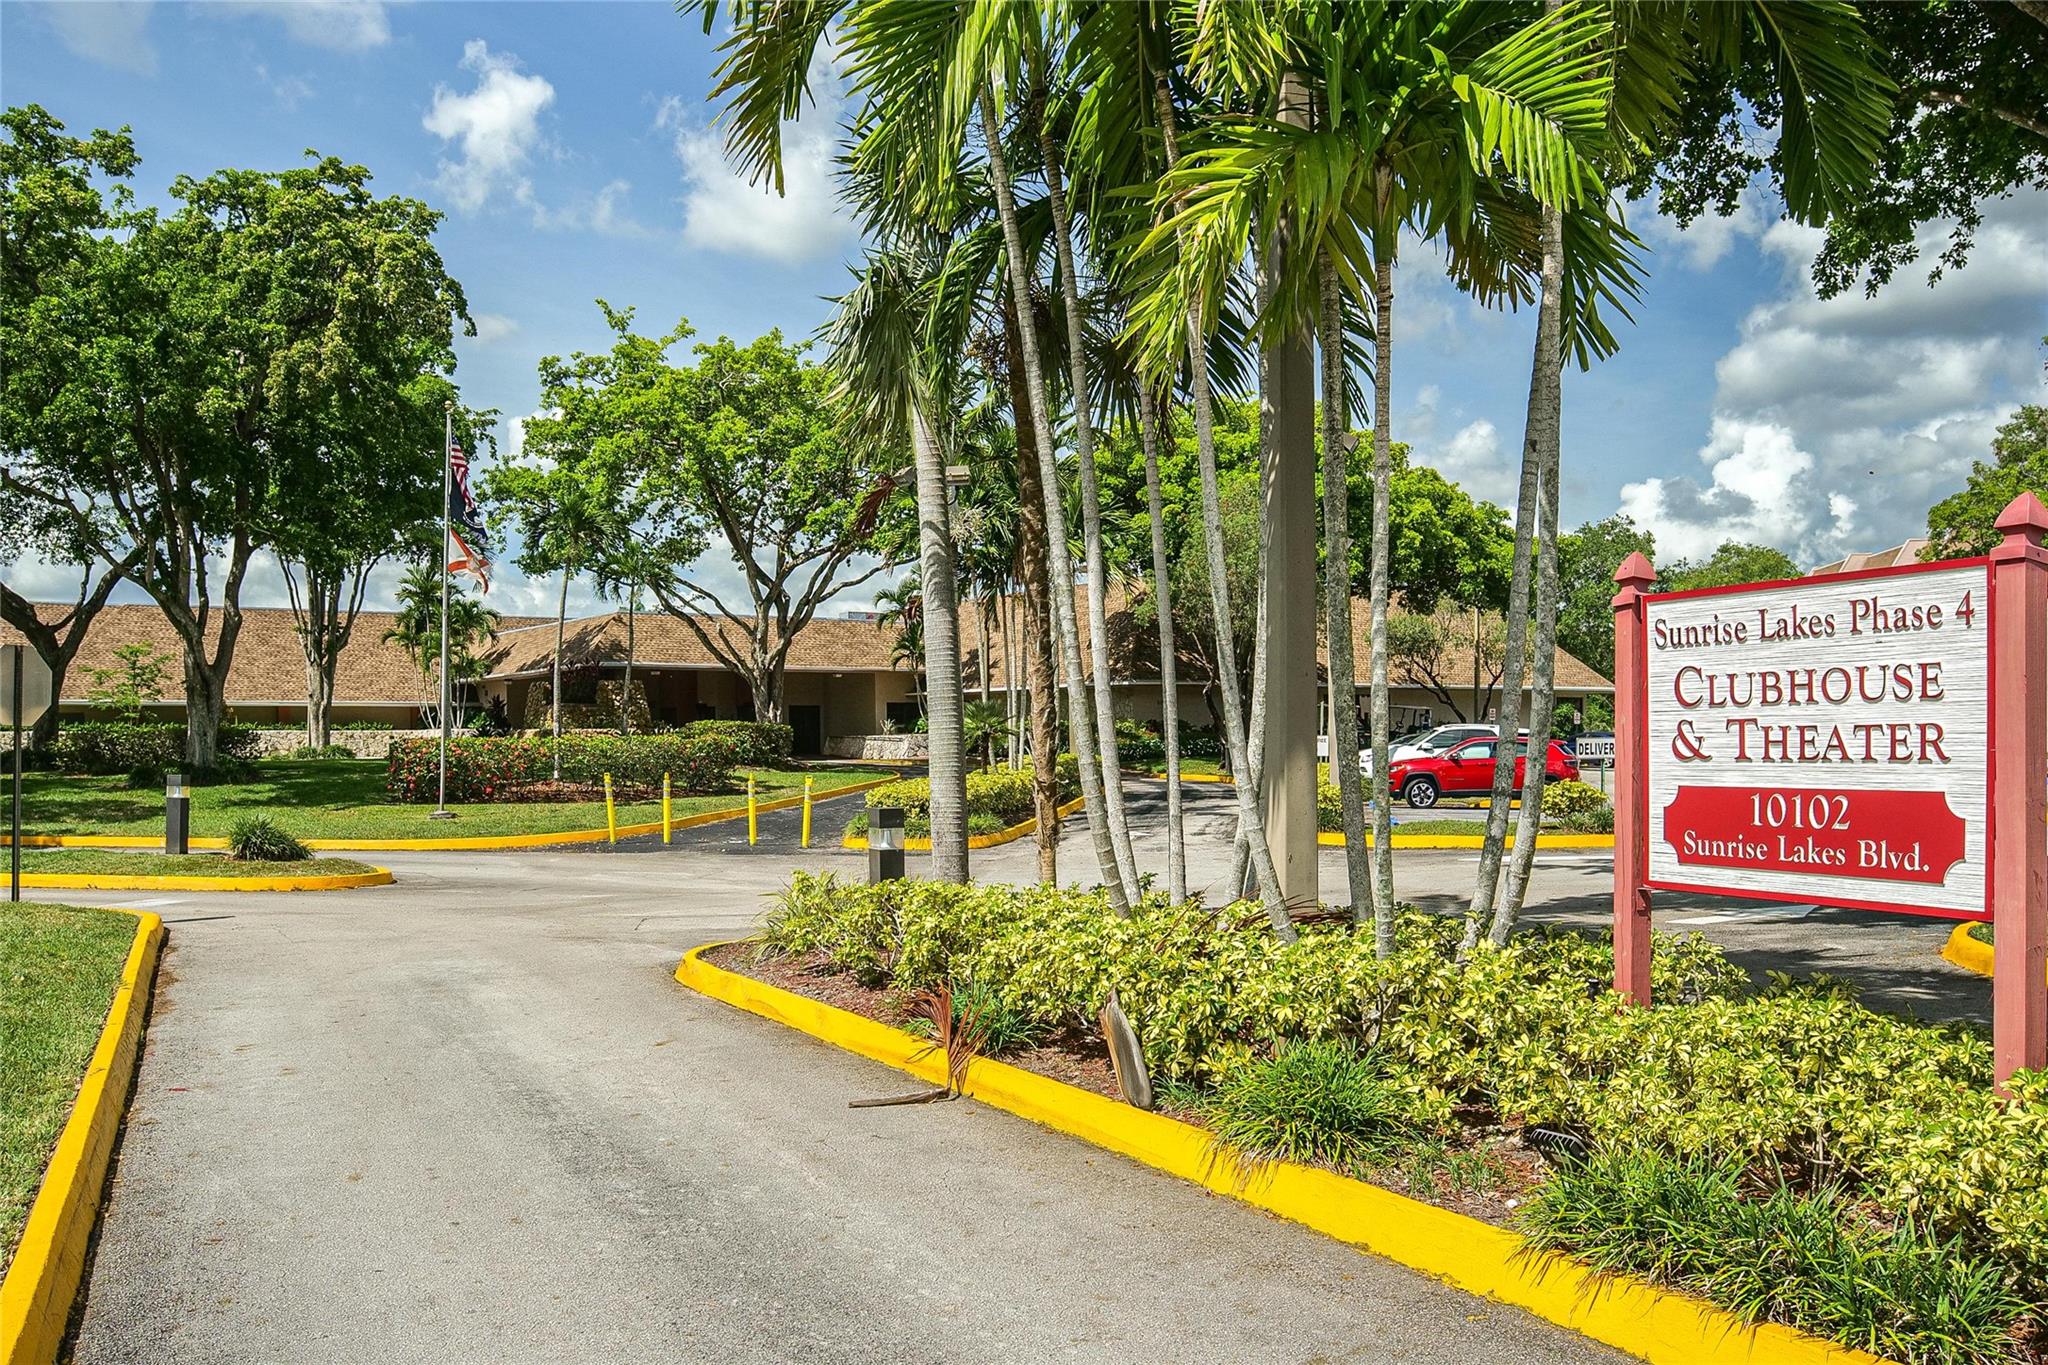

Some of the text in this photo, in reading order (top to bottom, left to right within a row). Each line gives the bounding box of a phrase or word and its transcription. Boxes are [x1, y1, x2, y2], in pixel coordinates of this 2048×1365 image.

[1654, 589, 1976, 650] Sunrise Lakes Phase 4
[1674, 661, 1945, 710] CLUBHOUSE
[1671, 717, 1952, 765] & THEATER
[1750, 792, 1851, 831] 10102
[1683, 829, 1930, 873] Sunrise Lakes Blvd.
